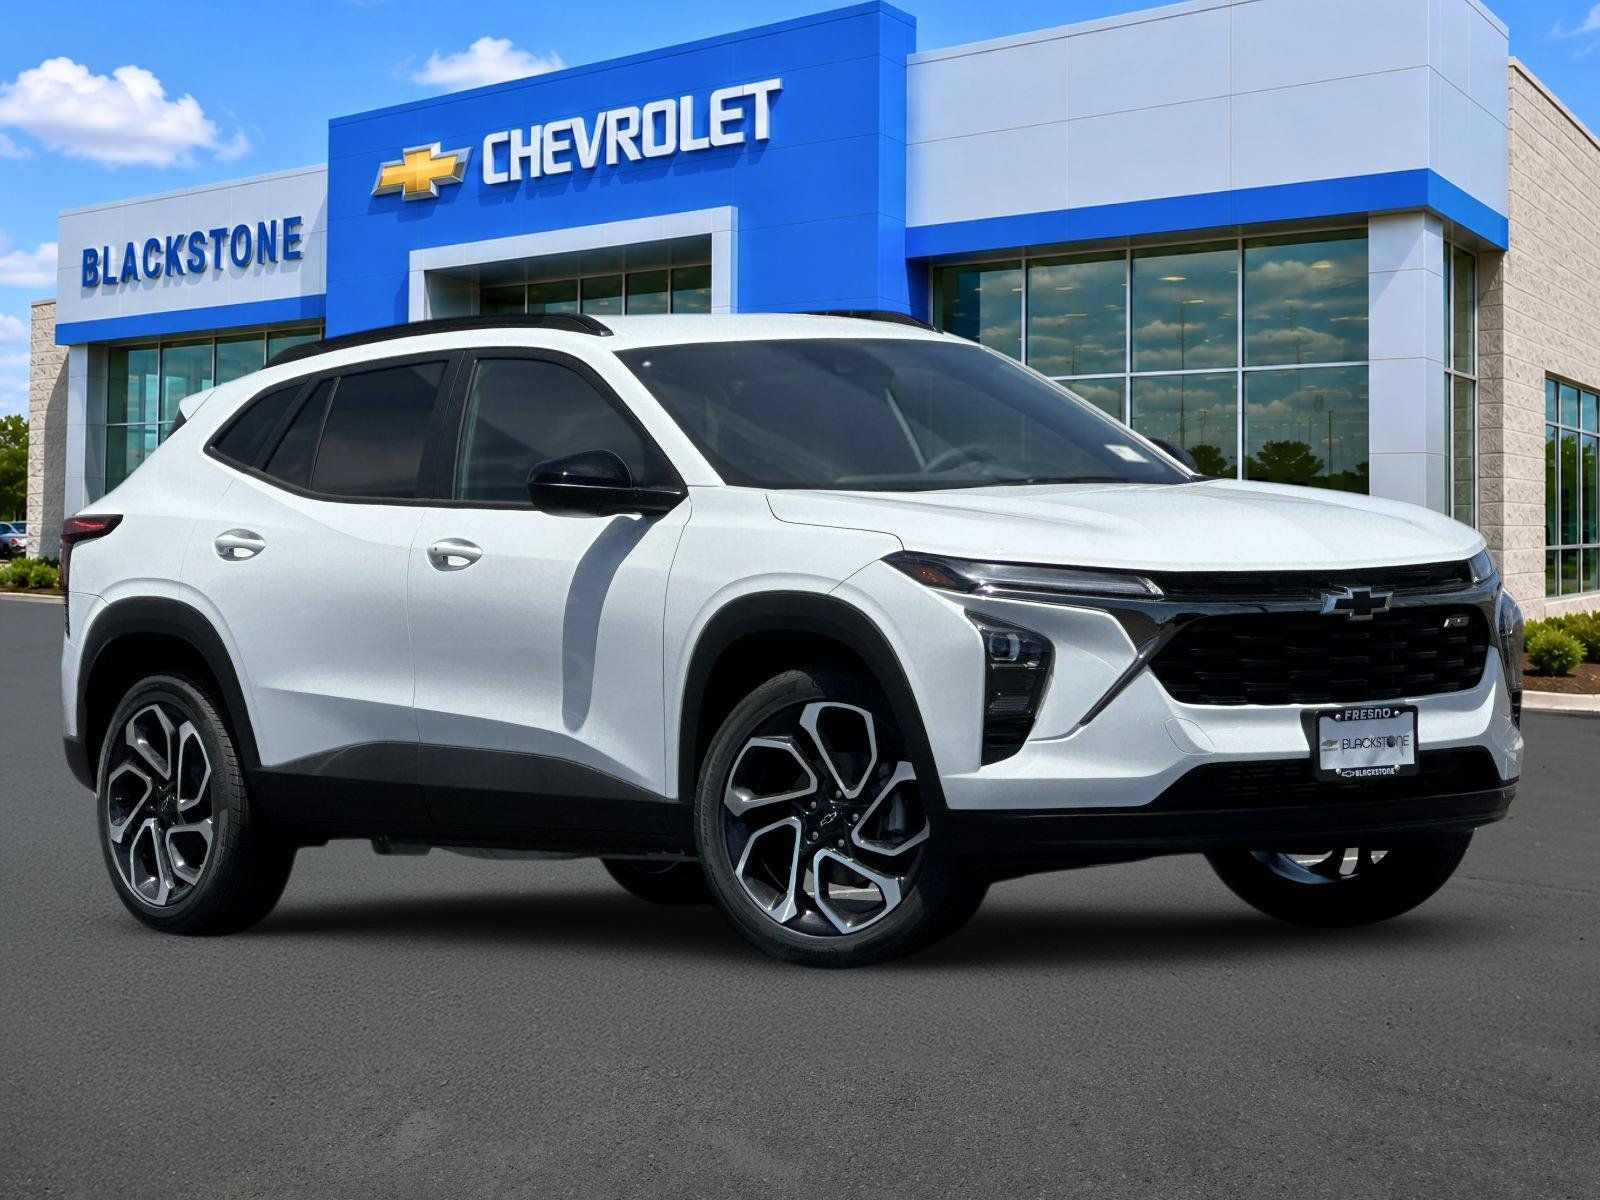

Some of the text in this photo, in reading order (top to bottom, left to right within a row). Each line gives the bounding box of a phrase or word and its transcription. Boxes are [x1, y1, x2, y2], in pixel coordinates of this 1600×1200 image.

[483, 78, 783, 185] CHEVROLET
[82, 215, 303, 288] BLACKSTONE
[1344, 707, 1391, 721] FRESNO
[1342, 734, 1410, 750] BLACKSTONE
[1355, 767, 1395, 777] BLACKSTONE
